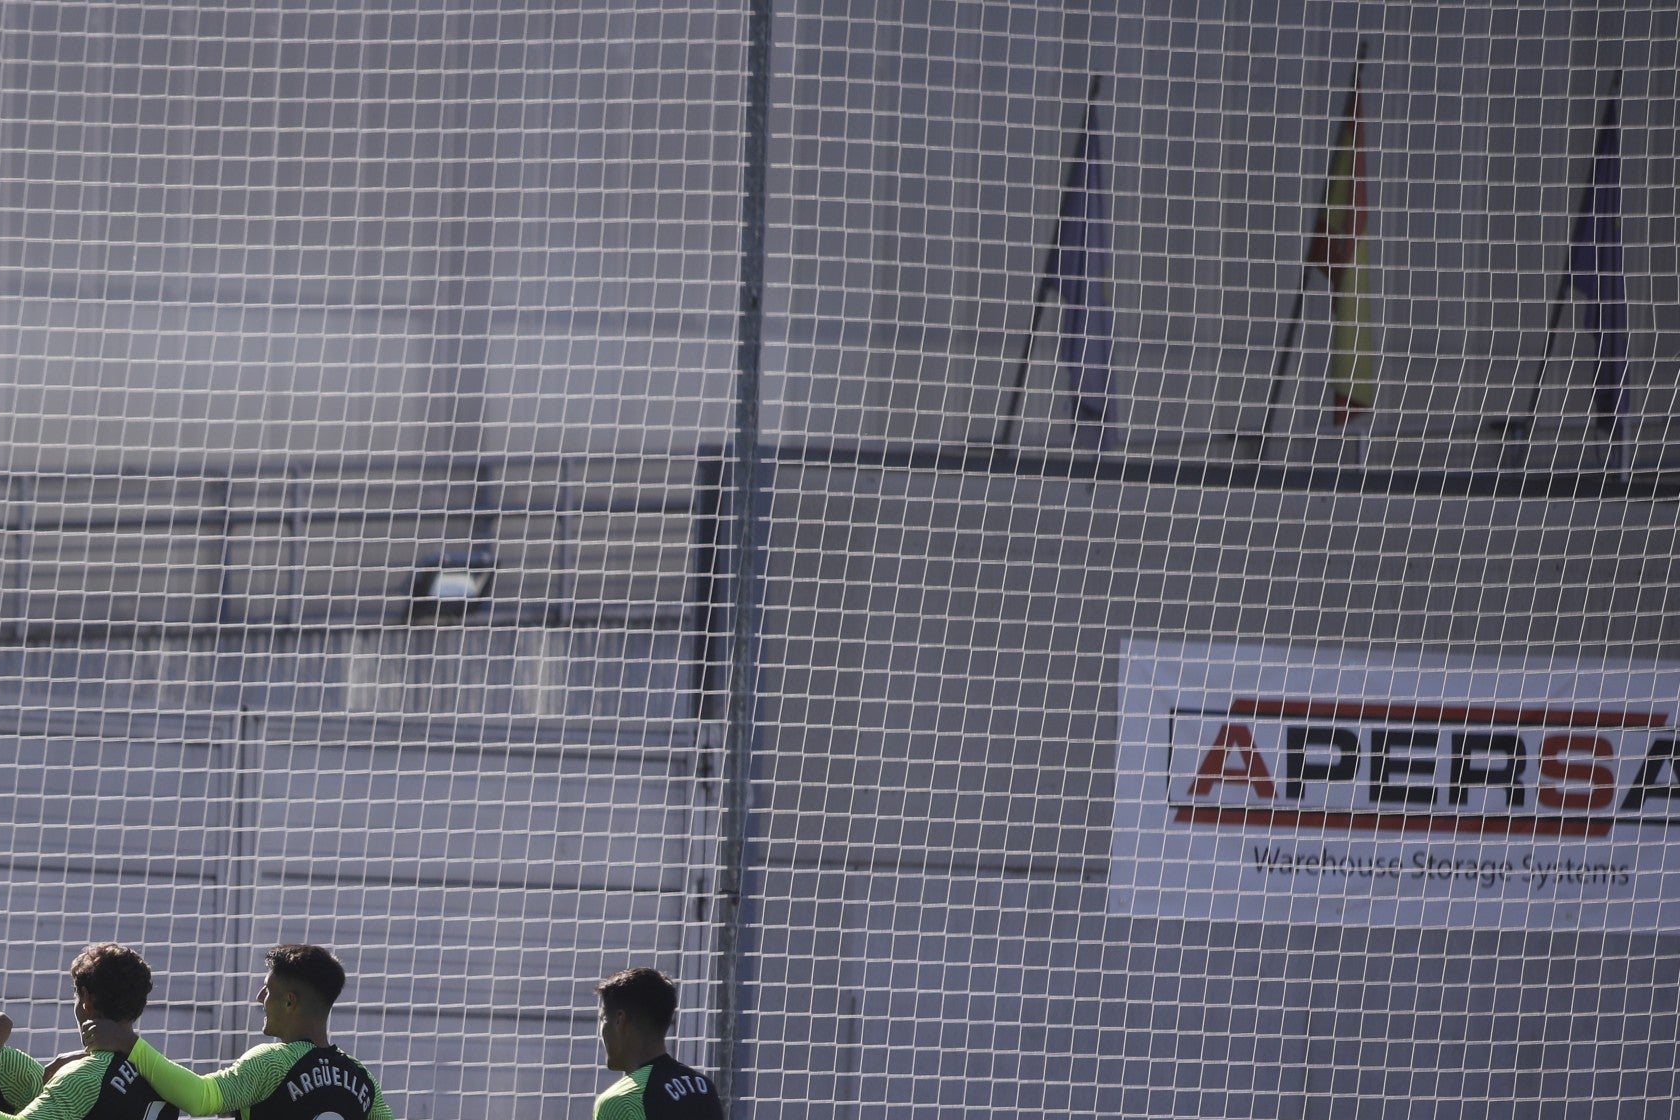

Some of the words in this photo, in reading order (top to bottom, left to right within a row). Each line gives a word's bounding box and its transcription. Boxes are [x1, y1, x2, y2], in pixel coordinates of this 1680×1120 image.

[1254, 846, 1402, 881] Warehouse
[1411, 850, 1513, 889] Storage
[1521, 854, 1630, 890] Systems
[110, 1060, 140, 1095] PEL
[286, 1058, 371, 1113] ARGÜELLES
[663, 1075, 709, 1101] COTO
